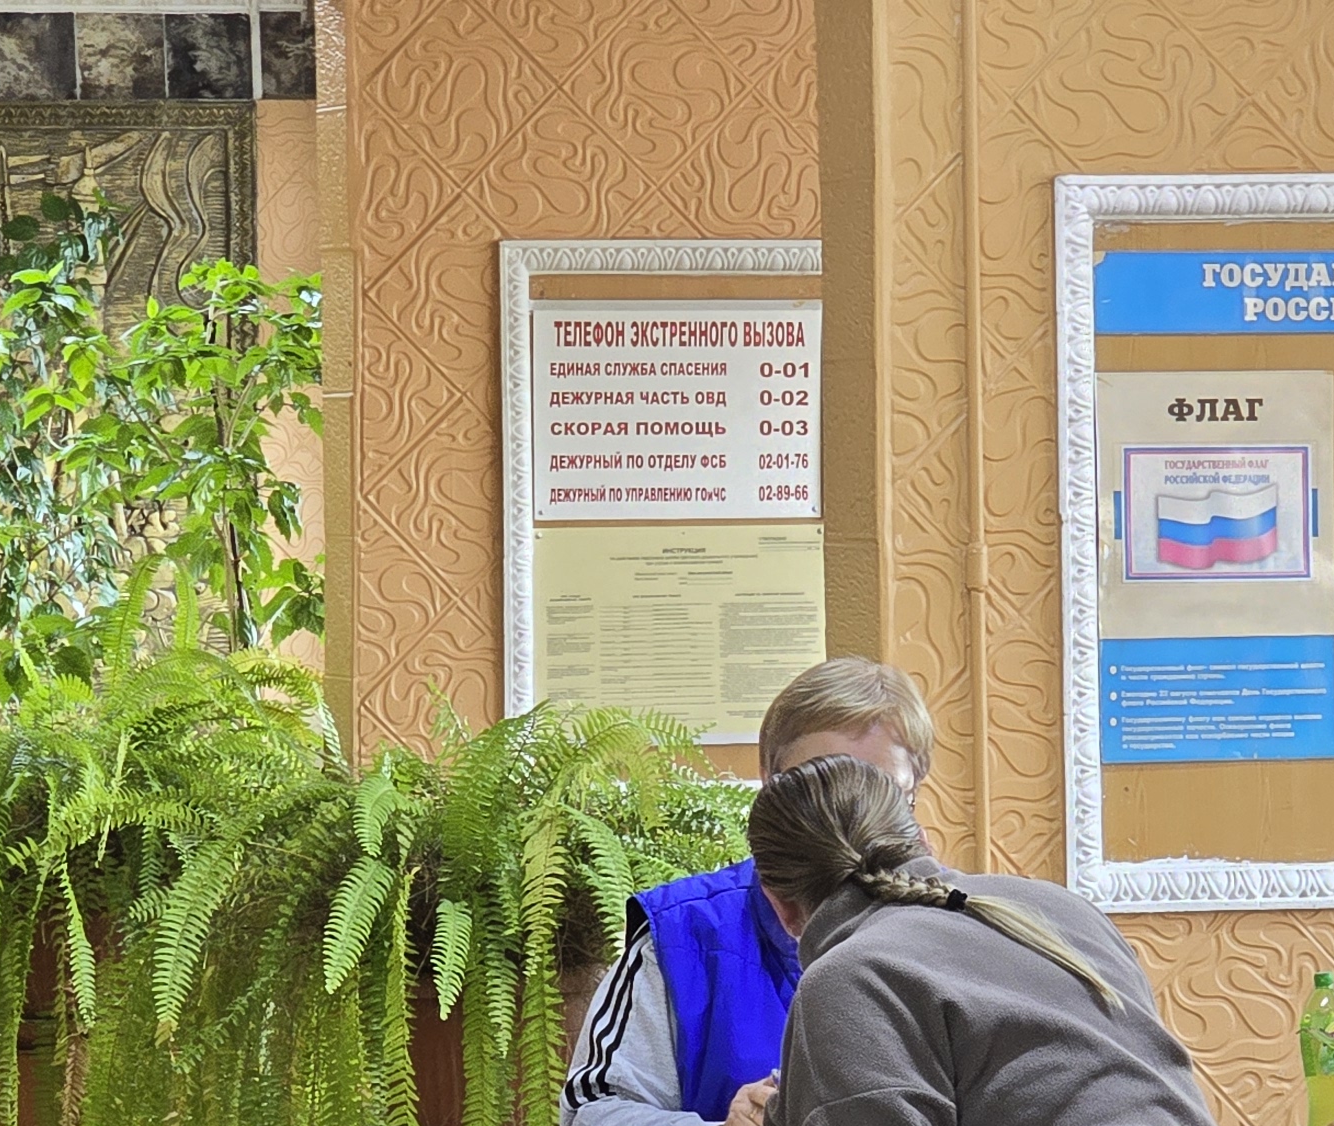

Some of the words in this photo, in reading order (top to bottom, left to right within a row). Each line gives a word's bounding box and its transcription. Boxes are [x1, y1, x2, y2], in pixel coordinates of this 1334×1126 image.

[554, 321, 626, 347] ТЕЛЕФОН
[630, 321, 738, 347] ЭКСТРЕННОГО
[743, 321, 805, 347] ВЫЗОВА
[550, 363, 600, 377] ЕДИНАЯ
[605, 363, 657, 376] СЛУЖБА
[660, 363, 727, 376] СПАСЕНИЯ
[759, 362, 810, 378] 0-01
[549, 392, 635, 408] ДЕЖУРНАЯ
[640, 392, 690, 405] ЧАСТЬ
[695, 391, 727, 407] ОВД
[759, 390, 809, 406] 0-02
[1167, 397, 1264, 423] ФЛАГ
[550, 422, 628, 436] СКОРАЯ
[635, 422, 726, 438] ПОМОЩЬ
[759, 420, 809, 436] 0-03
[549, 452, 623, 470] ДЕЖУРНЫЙ
[627, 455, 644, 468] ПО
[648, 455, 696, 470] ОТДЕЛУ
[700, 454, 726, 468] ФСБ
[759, 453, 809, 469] 02-01-76
[1164, 458, 1246, 470] ГОСУДАРСТВЕННЫЙ
[1248, 460, 1269, 469] ФЛАГ
[1164, 472, 1220, 484] РОССИЙСКОЙ
[1222, 474, 1270, 485] ФЕДЕРАЦИИ
[549, 485, 606, 503] ДЕЖУРНЫЙ
[609, 488, 622, 502] ПО
[625, 488, 692, 502] УПРАВЛЕНИЮ
[695, 488, 726, 501] ГОиЧС
[759, 485, 809, 501] 02-89-66
